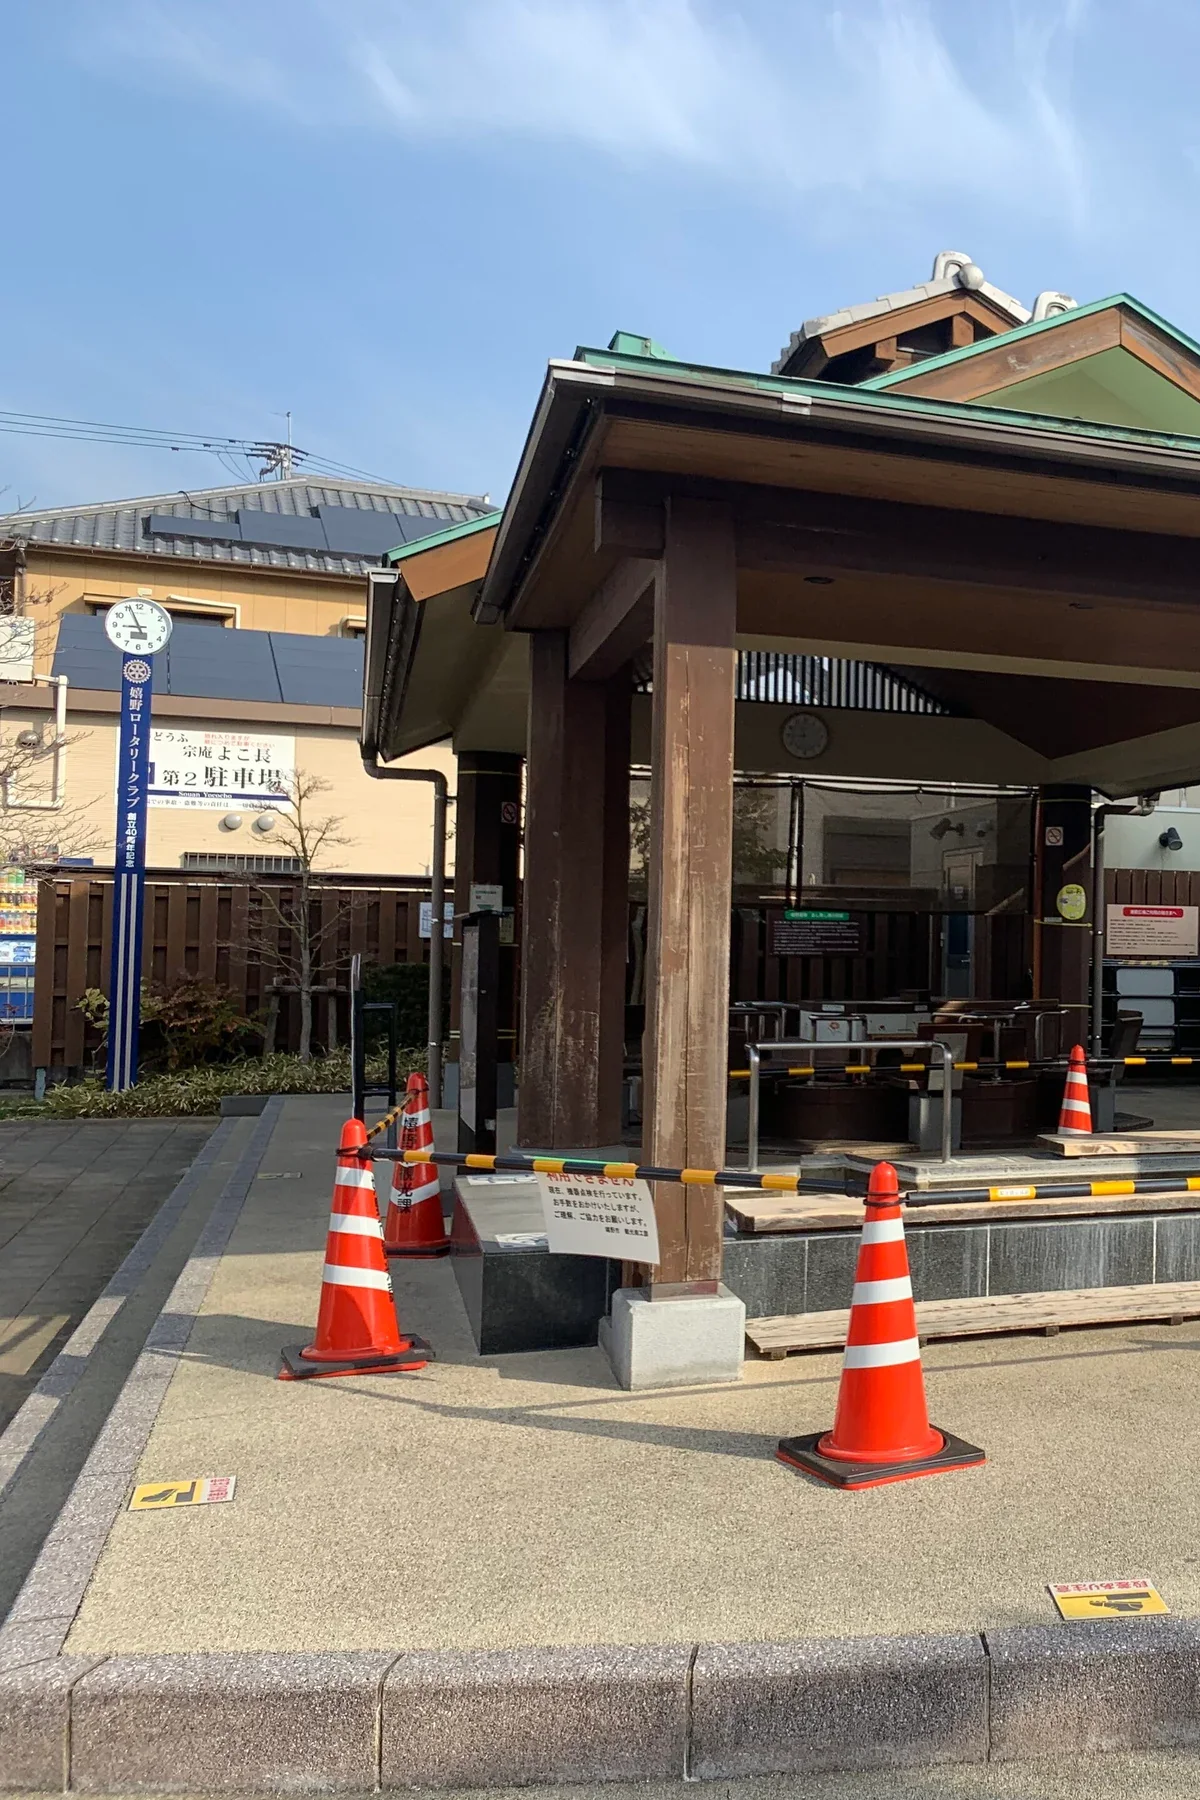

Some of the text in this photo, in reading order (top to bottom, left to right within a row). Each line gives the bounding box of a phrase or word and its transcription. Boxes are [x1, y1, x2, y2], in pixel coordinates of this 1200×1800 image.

[126, 687, 143, 808] 嬉野ロータリークラブ
[163, 766, 282, 789] 第2駐車場
[183, 745, 271, 763] 宗庵よこ長
[397, 1117, 419, 1214] 嬉野観光課
